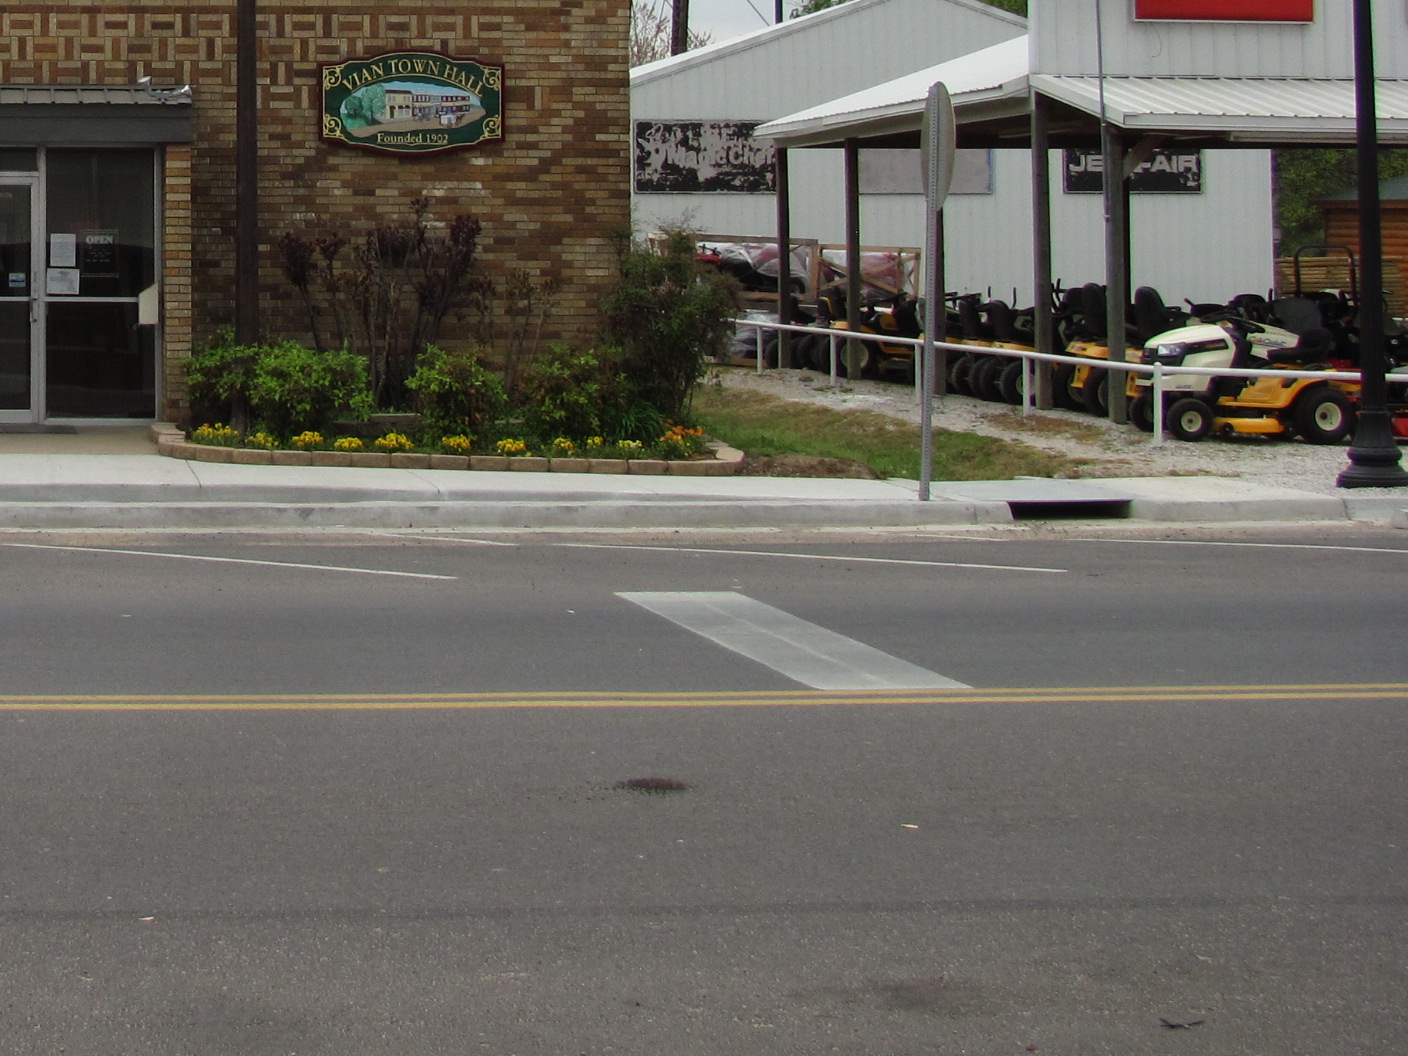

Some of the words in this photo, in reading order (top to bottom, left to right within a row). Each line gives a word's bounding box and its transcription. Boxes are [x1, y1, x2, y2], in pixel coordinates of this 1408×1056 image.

[341, 62, 385, 92] VIAN
[388, 58, 441, 76] TOWN
[442, 63, 485, 98] HALL
[377, 133, 423, 144] Founded
[425, 133, 449, 145] 1902
[86, 235, 114, 244] OPEN
